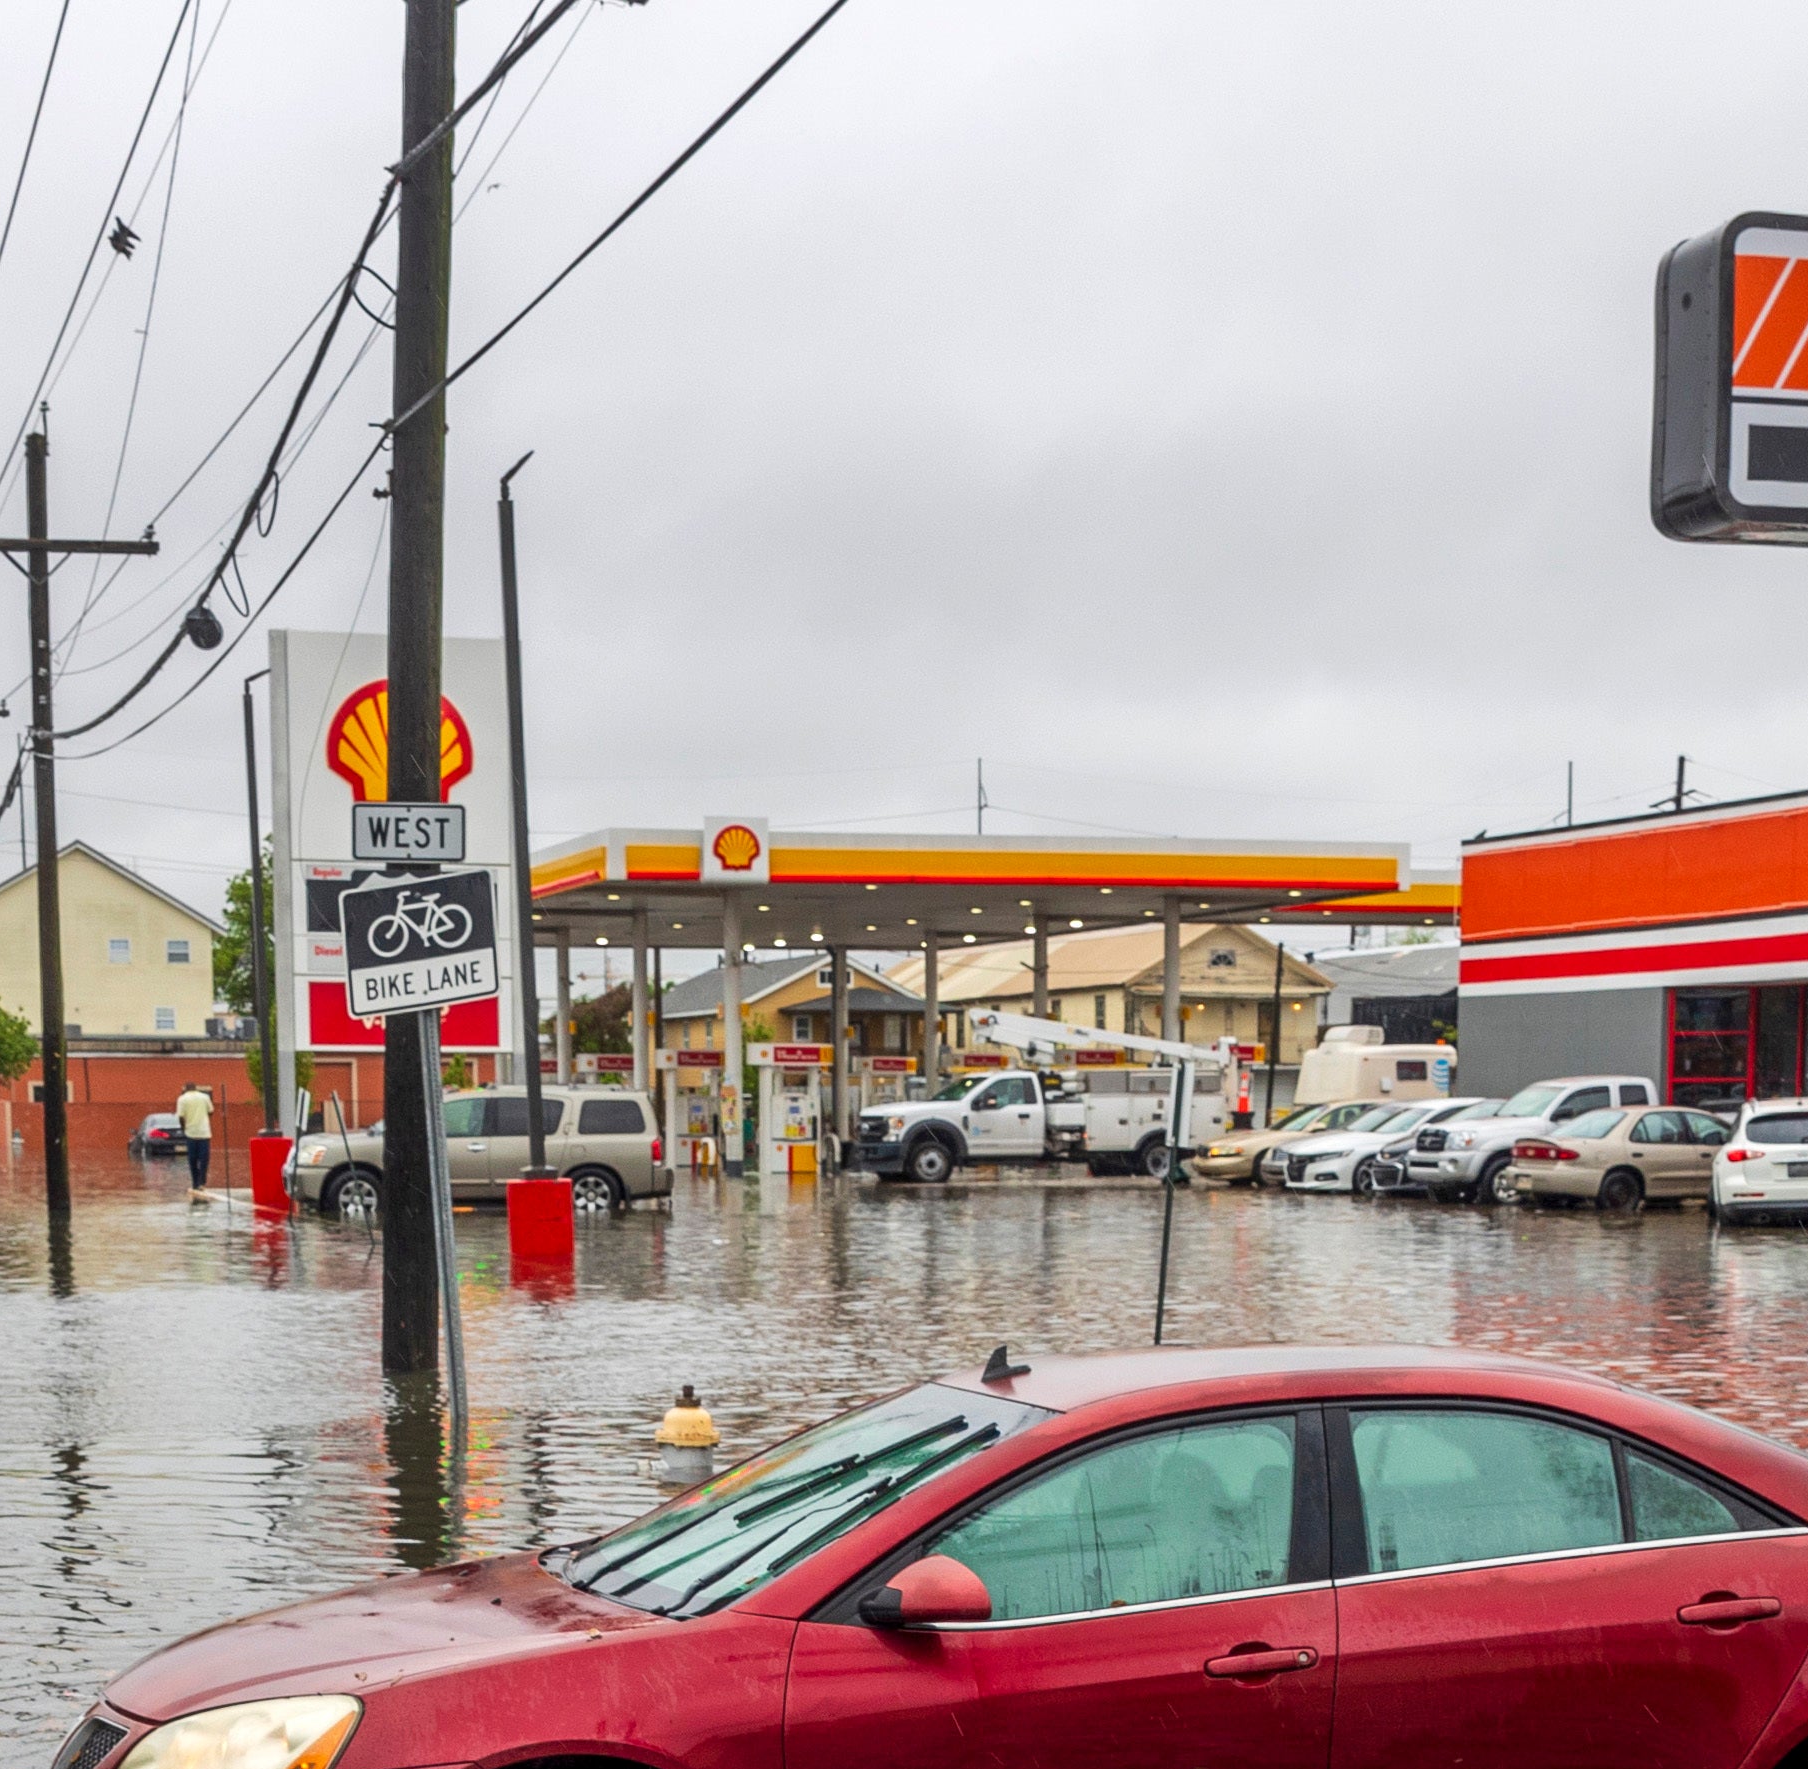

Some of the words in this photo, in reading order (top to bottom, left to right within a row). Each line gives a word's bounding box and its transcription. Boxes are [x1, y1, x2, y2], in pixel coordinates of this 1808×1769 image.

[368, 816, 450, 849] WEST
[312, 866, 342, 879] Regular
[314, 945, 342, 956] Diesel
[365, 972, 416, 1001] BIKE
[426, 960, 483, 992] LANE
